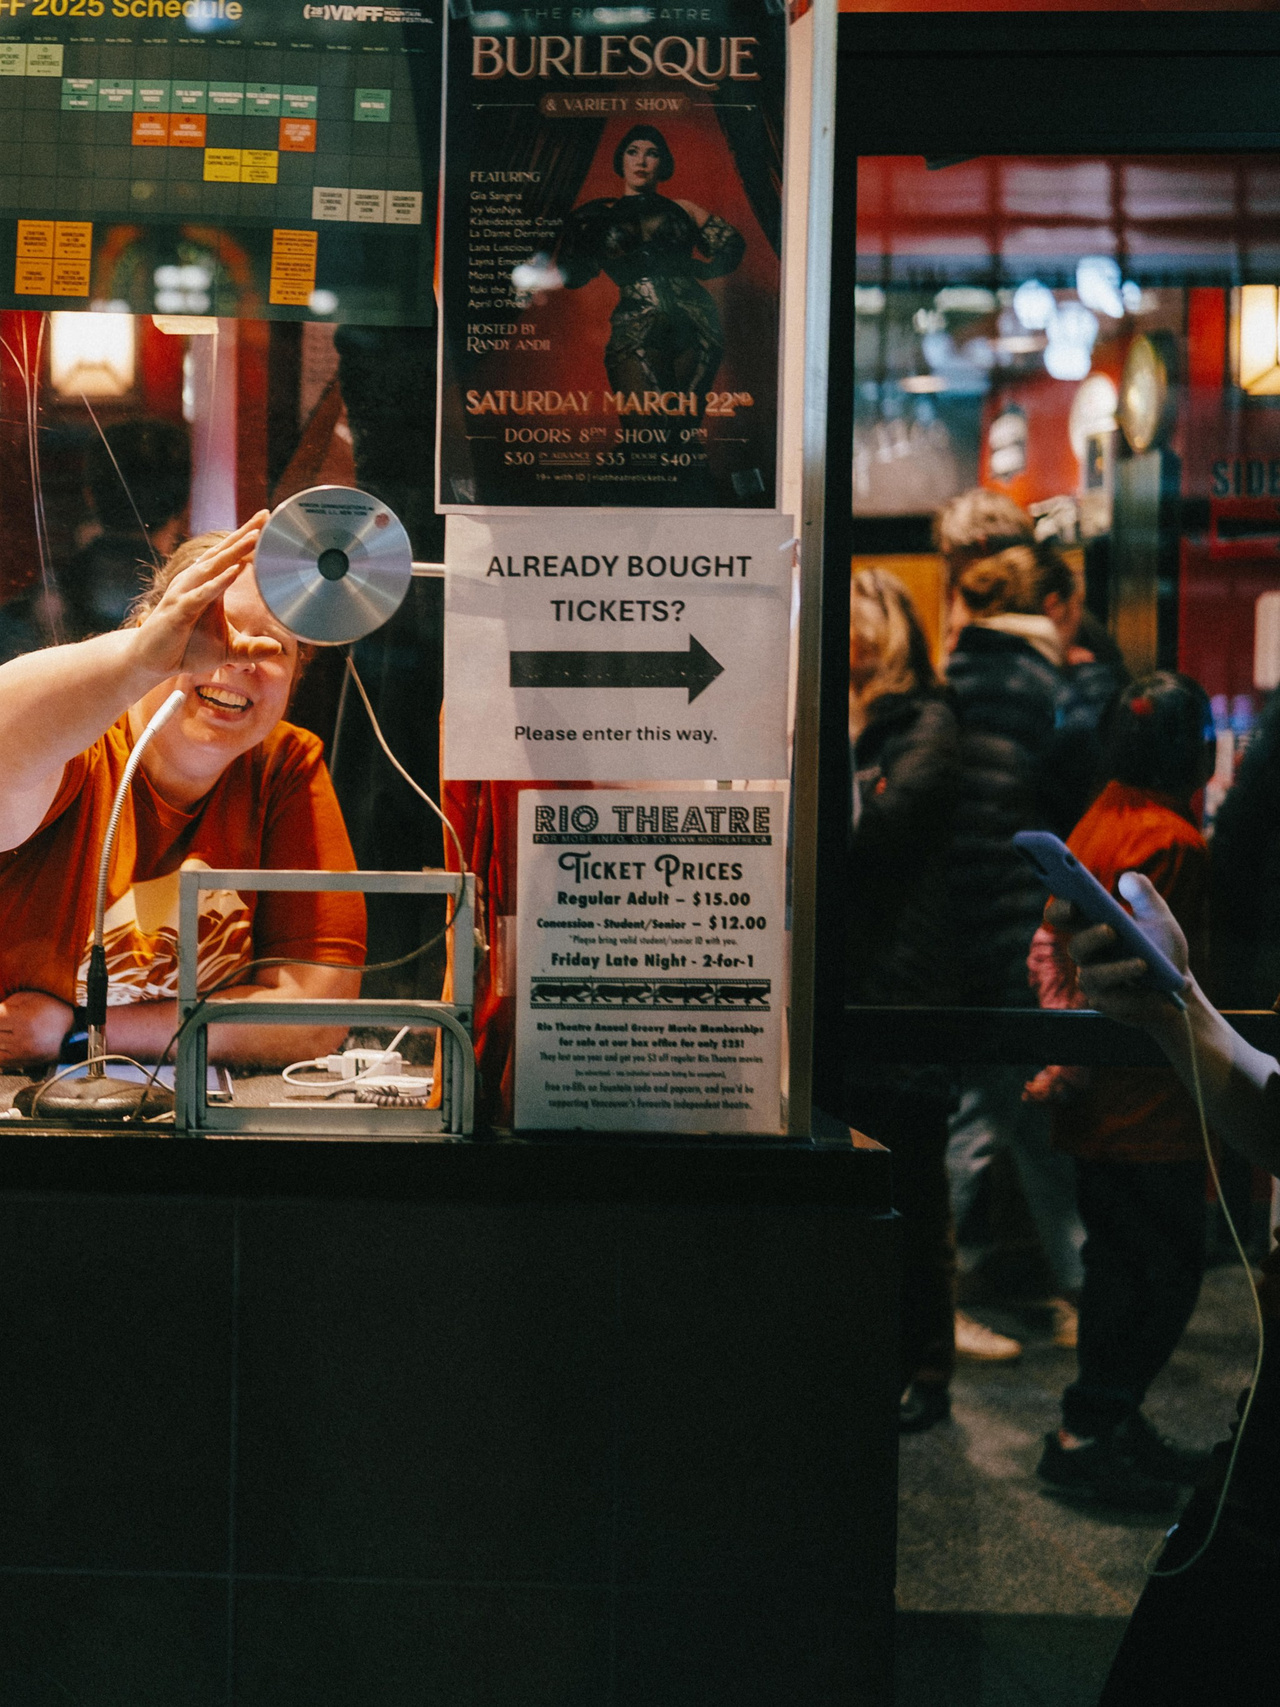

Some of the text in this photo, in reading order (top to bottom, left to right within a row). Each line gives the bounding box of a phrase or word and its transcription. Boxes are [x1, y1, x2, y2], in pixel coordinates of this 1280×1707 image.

[32, 0, 105, 17] 2025
[471, 35, 761, 91] BURLESQUE
[545, 99, 682, 112] & VARIETY SHOW
[470, 171, 541, 183] FEATURING
[467, 324, 537, 335] HOSTED BY
[467, 336, 510, 354] RANDY
[466, 390, 754, 417] SATURDAY MARCH 22ND
[504, 427, 708, 444] DOORS 8PM SHOW 9PM
[504, 451, 691, 466] $30 $35 $40
[486, 555, 752, 578] ALREADY BOUGHT
[550, 600, 686, 622] TICKETS?
[514, 726, 718, 743] Please enter this way.
[535, 805, 770, 834] RIO THEATRE
[557, 890, 750, 908] Regular Adult $15.00
[537, 915, 767, 931] Concession Student/Senior $12.00
[551, 952, 754, 970] Friday Late Night 2-for-1
[537, 1022, 764, 1035] Rio Theatre Annual Groovy Movie Memberships
[559, 1037, 574, 1047] for
[576, 1037, 596, 1047] sale
[599, 1038, 609, 1047] at
[612, 1039, 628, 1047] our
[631, 1037, 648, 1047] box
[651, 1038, 677, 1047] office
[680, 1038, 695, 1047] for
[697, 1038, 718, 1050] only
